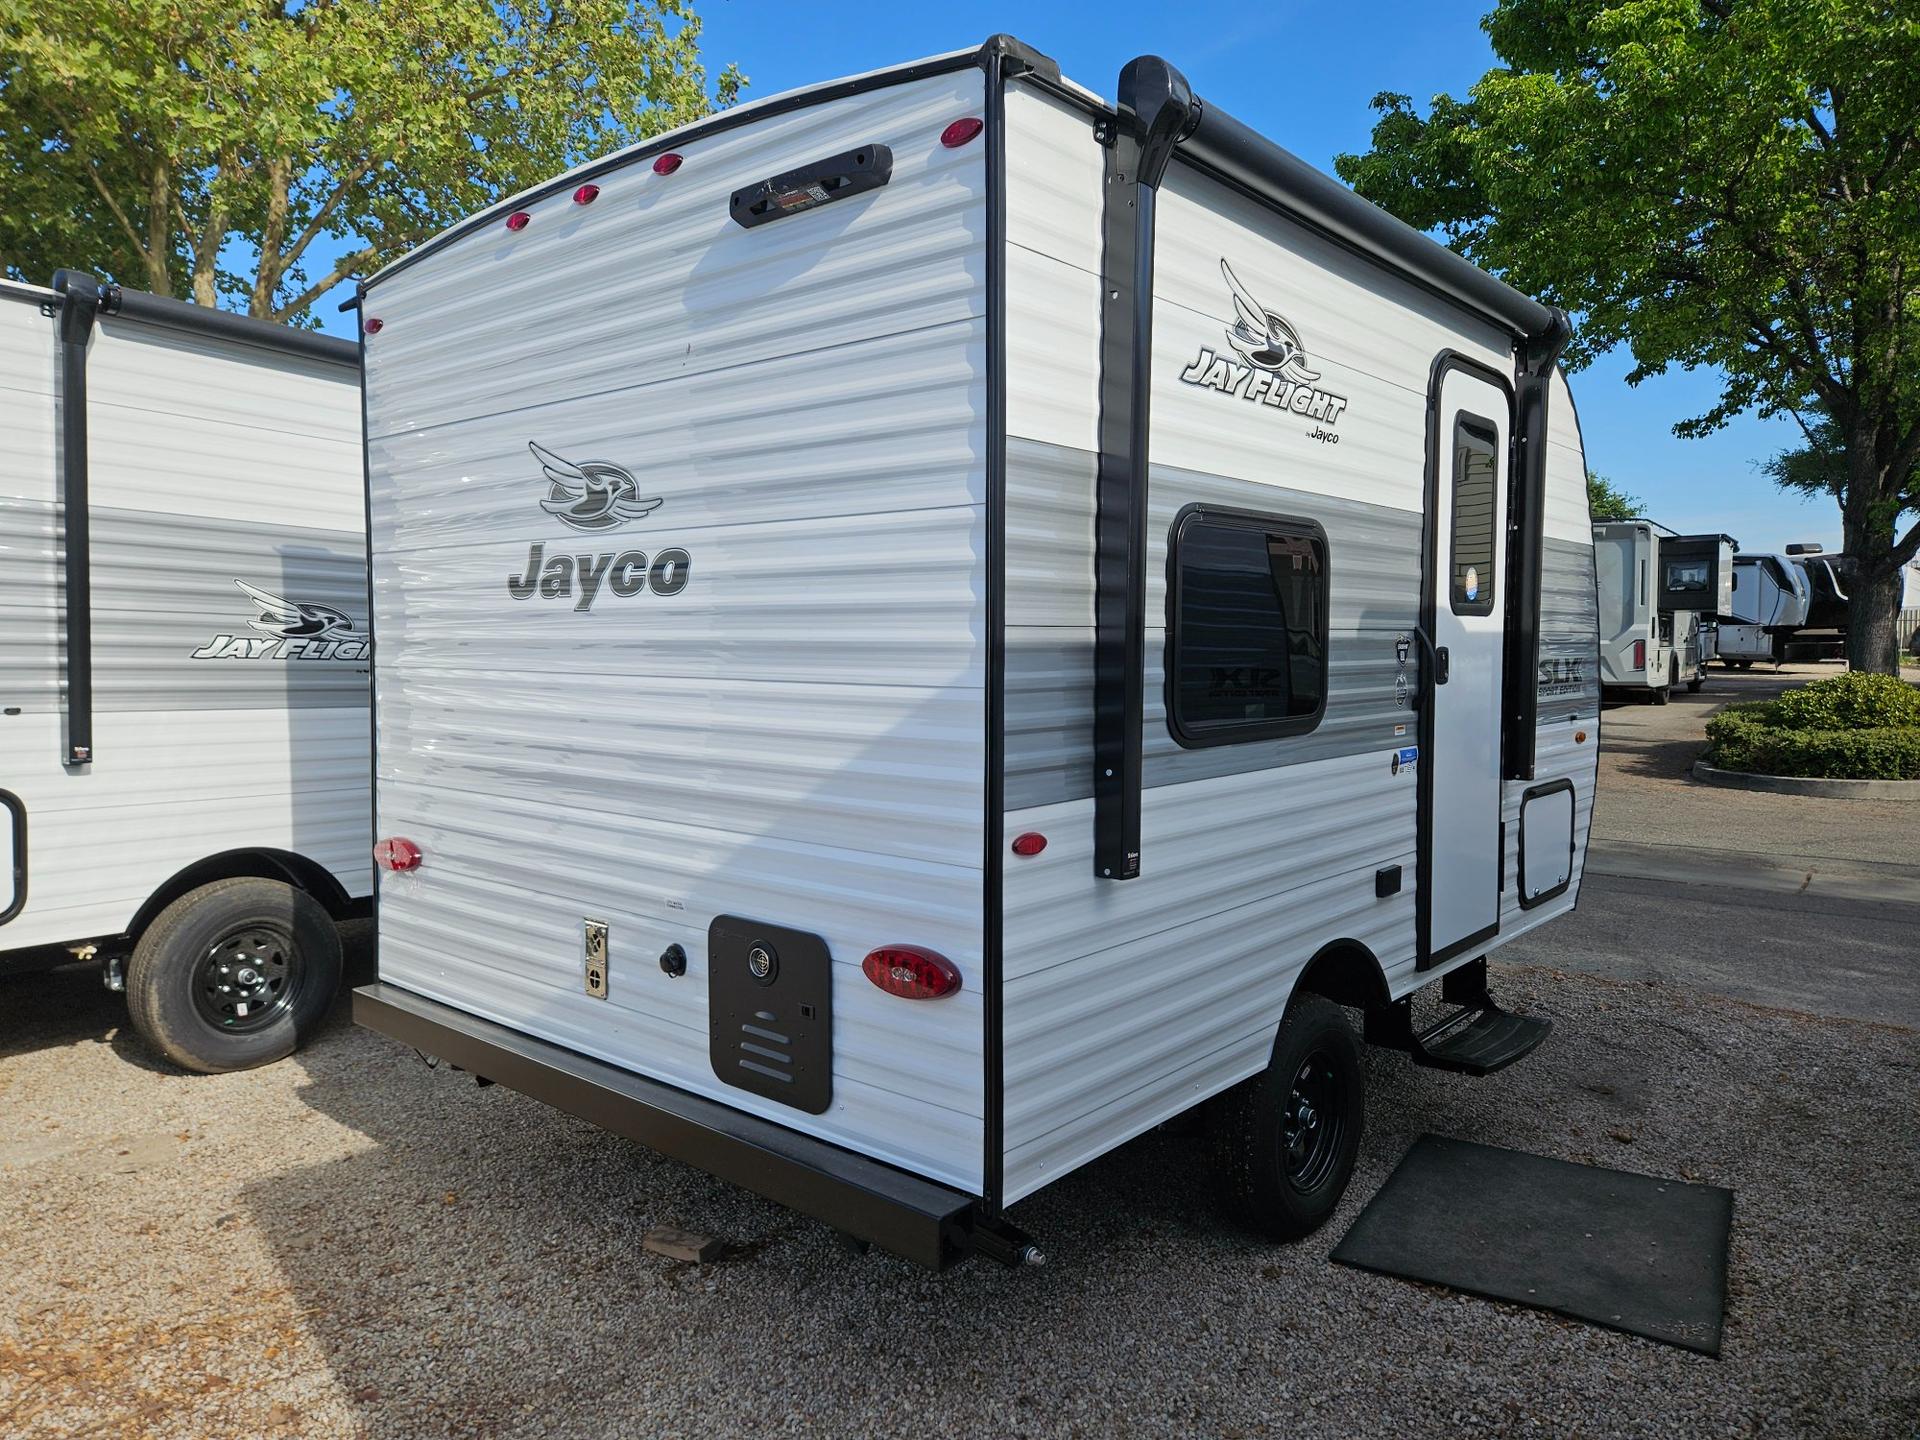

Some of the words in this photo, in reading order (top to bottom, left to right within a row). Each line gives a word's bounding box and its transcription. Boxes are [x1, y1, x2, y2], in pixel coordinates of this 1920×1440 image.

[1179, 344, 1250, 395] JAY
[1244, 368, 1348, 425] FLIGHT
[1311, 425, 1339, 444] Jayco
[508, 541, 692, 612] Jayco
[190, 634, 282, 660] JAY
